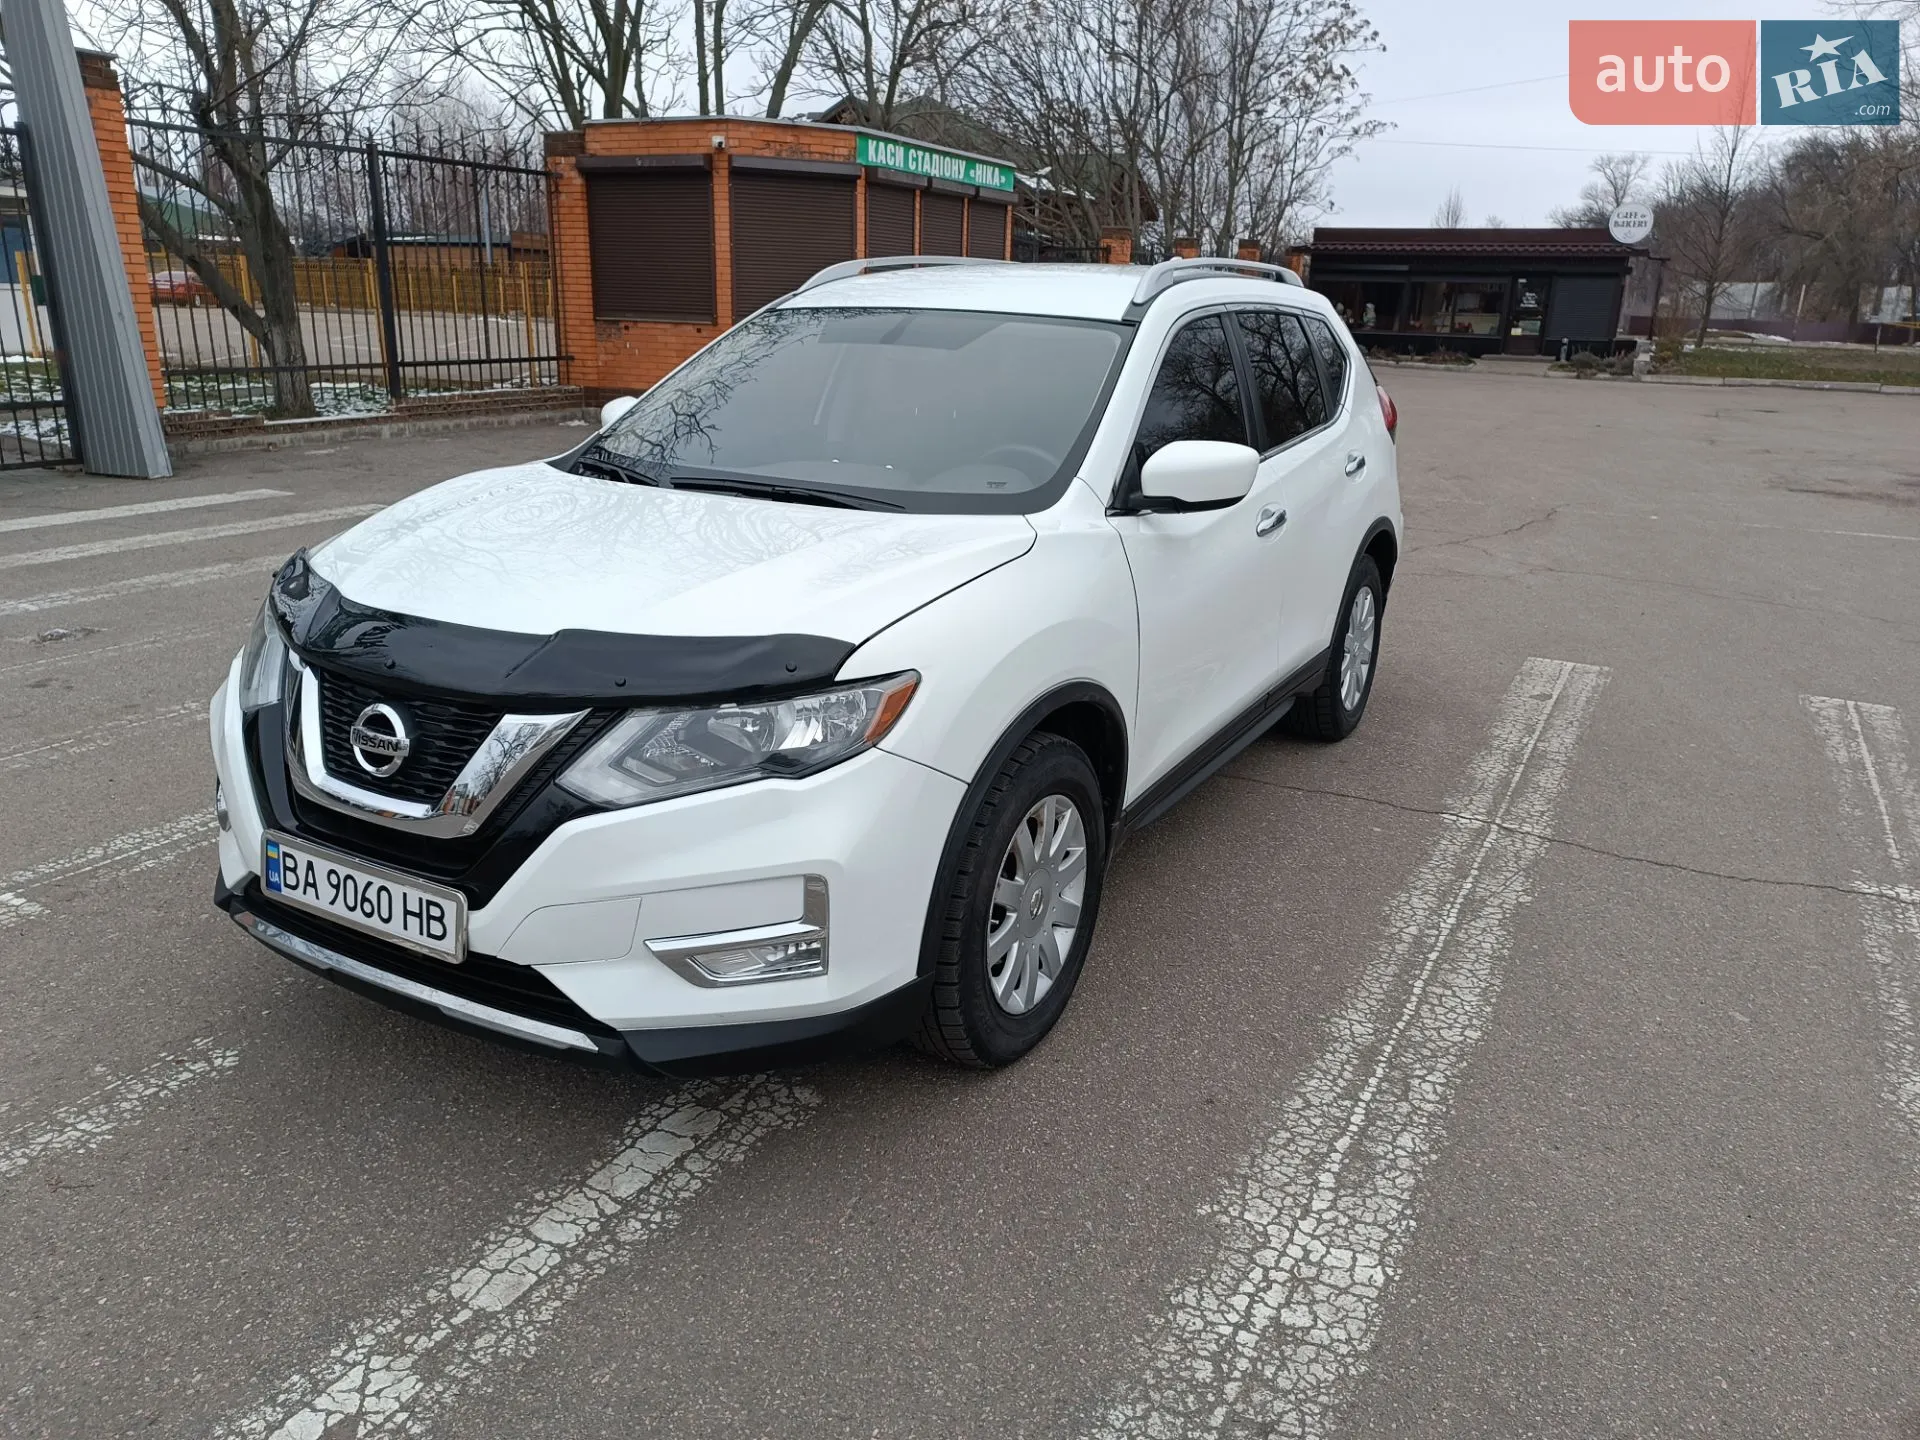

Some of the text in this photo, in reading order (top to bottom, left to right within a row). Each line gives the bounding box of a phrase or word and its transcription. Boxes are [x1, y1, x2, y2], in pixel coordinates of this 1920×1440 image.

[867, 138, 1006, 188] КАСИ СТАДІОНУ «НІКА»
[352, 728, 399, 752] NISSAN
[268, 869, 281, 884] UA
[281, 850, 448, 941] BA 9060 HB
